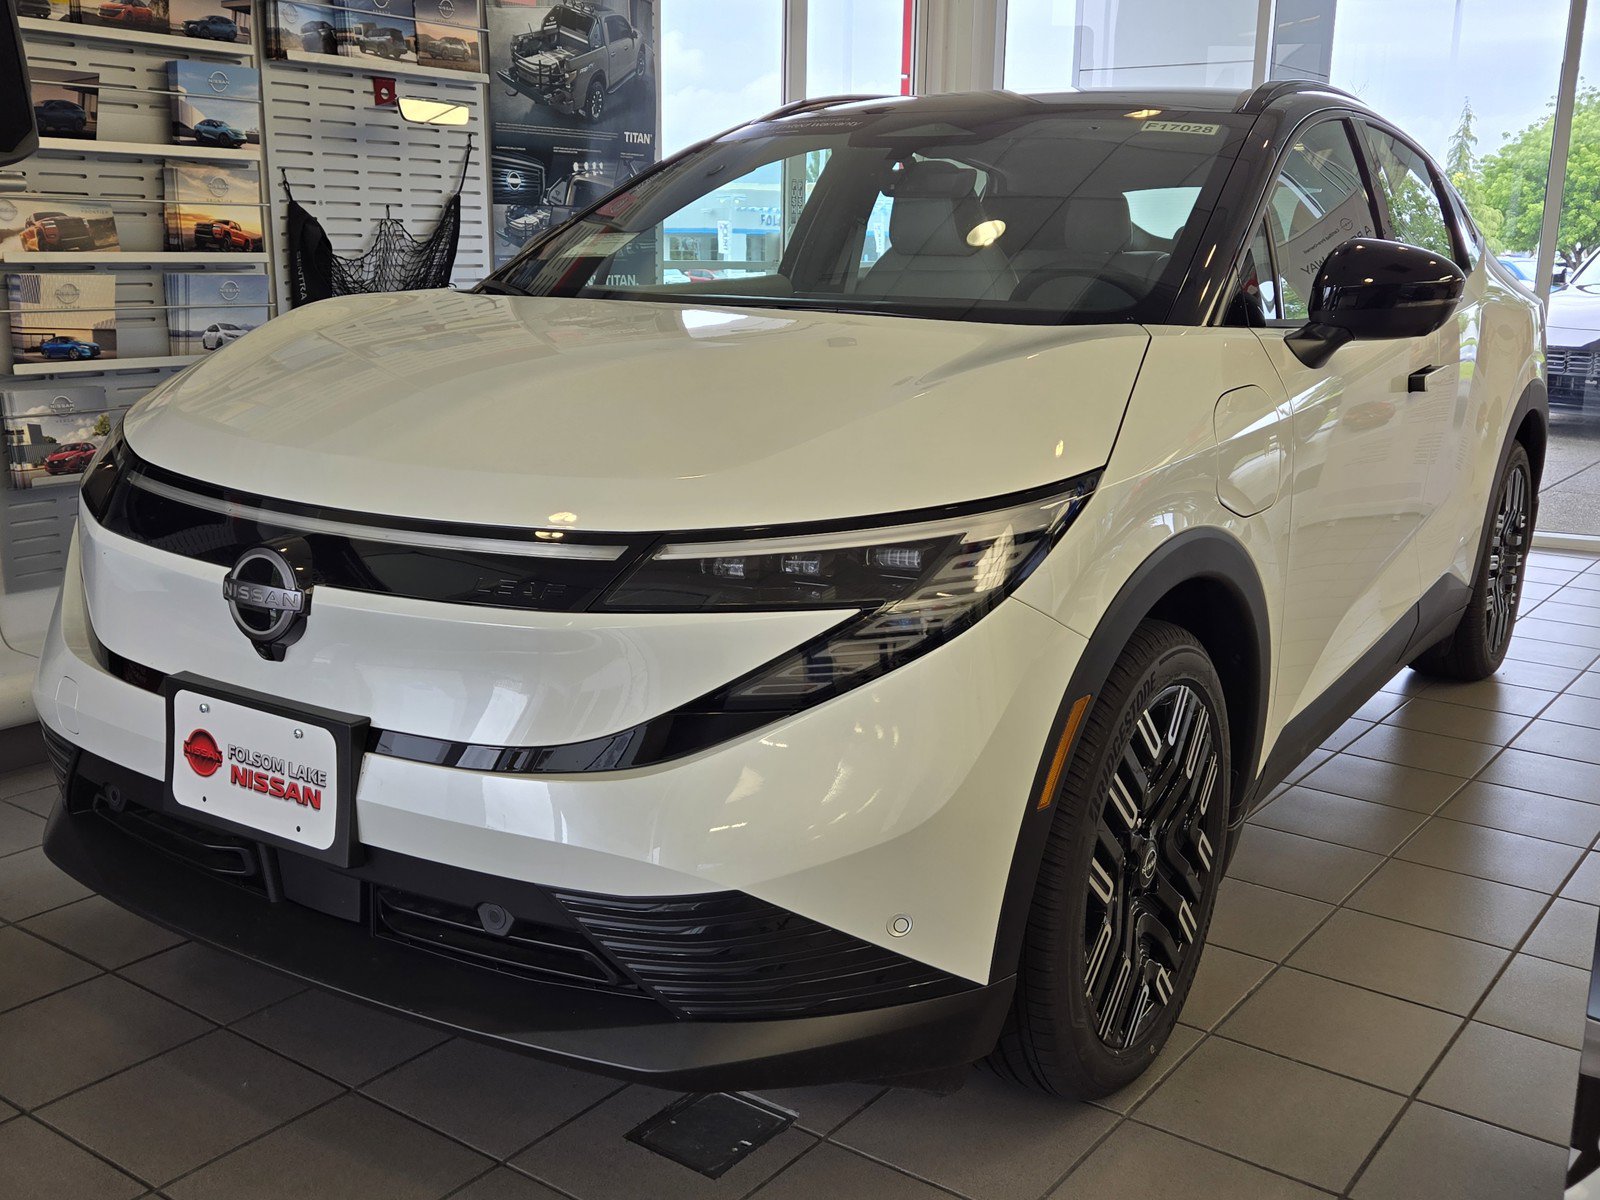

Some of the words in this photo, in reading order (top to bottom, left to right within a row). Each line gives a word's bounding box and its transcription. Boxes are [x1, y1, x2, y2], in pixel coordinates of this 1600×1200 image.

[623, 131, 651, 145] TITAN
[1145, 122, 1214, 134] F17028
[760, 214, 779, 227] FOL
[224, 582, 299, 608] NISSAN
[183, 742, 223, 763] NISSAN
[1088, 670, 1157, 824] BRIDGESTONE
[227, 744, 286, 776] FOLSOM
[288, 761, 328, 789] LAKE
[230, 763, 322, 811] NISSAN
